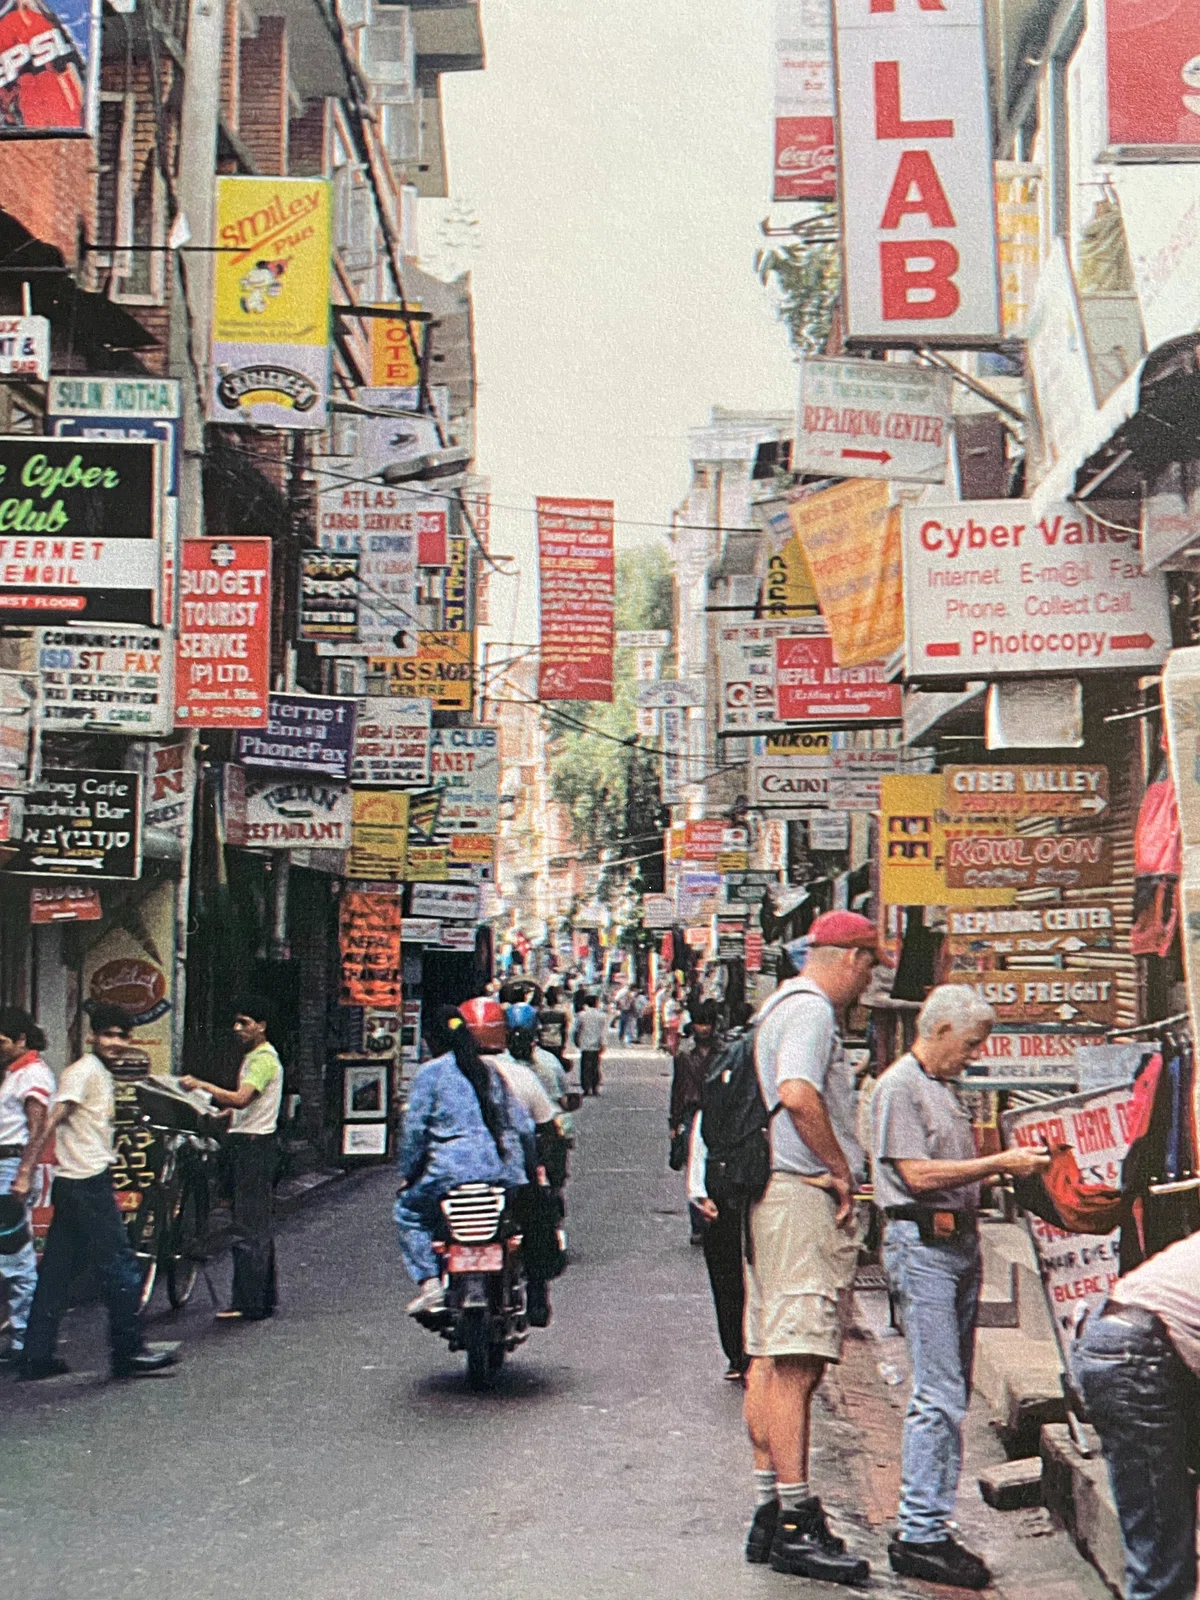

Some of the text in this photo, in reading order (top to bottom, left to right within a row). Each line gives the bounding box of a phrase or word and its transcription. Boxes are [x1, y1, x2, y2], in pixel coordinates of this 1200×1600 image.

[21, 453, 120, 498] Cyber
[342, 490, 397, 508] ATLAS
[920, 515, 1140, 557] Cyber Valle
[180, 569, 265, 595] BUDGET
[184, 601, 258, 626] TOURIST
[1024, 595, 1090, 617] Collect
[180, 632, 248, 658] SERVICE
[971, 630, 1106, 656] Photocopy
[40, 649, 73, 669] ISD
[125, 652, 162, 673] FAX
[777, 668, 819, 684] NEPAL
[240, 737, 310, 760] Phone
[452, 731, 496, 747] CLUB
[766, 734, 828, 747] Nikon
[954, 771, 1100, 792] CYBER VALLEY
[95, 801, 131, 818] Bar
[1044, 907, 1112, 930] CENTER
[1024, 982, 1111, 1003] FREIGHT
[1072, 1107, 1117, 1155] HAIR
